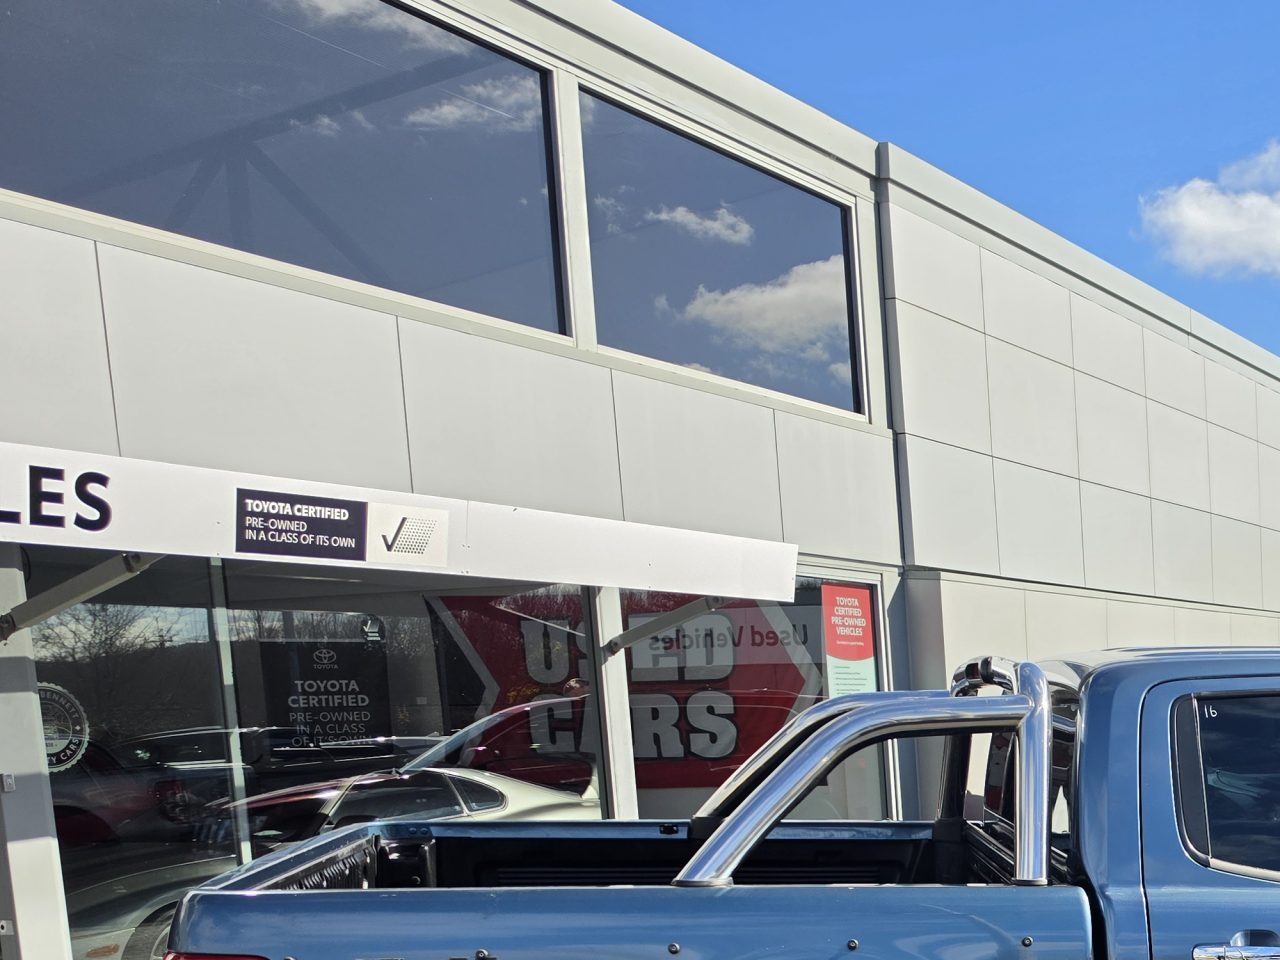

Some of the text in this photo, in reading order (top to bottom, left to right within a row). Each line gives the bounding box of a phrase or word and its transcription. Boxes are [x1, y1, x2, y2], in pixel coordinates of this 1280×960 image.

[245, 499, 349, 521] TOYOTA CERTIFIED
[245, 516, 307, 532] PRE-OWNED
[245, 529, 356, 548] IN A CLASS OF ITS OWN
[836, 596, 859, 606] TOYOTA
[834, 606, 862, 616] CERTIFIED
[831, 616, 866, 627] PRE-OWNED
[836, 626, 863, 636] VEHICLES
[520, 612, 734, 684] UED
[294, 680, 360, 692] TOYOTA
[287, 694, 369, 708] CERTIFIED
[289, 711, 371, 722] PRE-OWNED
[1204, 704, 1218, 718] 16
[296, 722, 366, 735] IN A CLASS
[291, 735, 311, 747] OF
[60, 737, 79, 760] CARS
